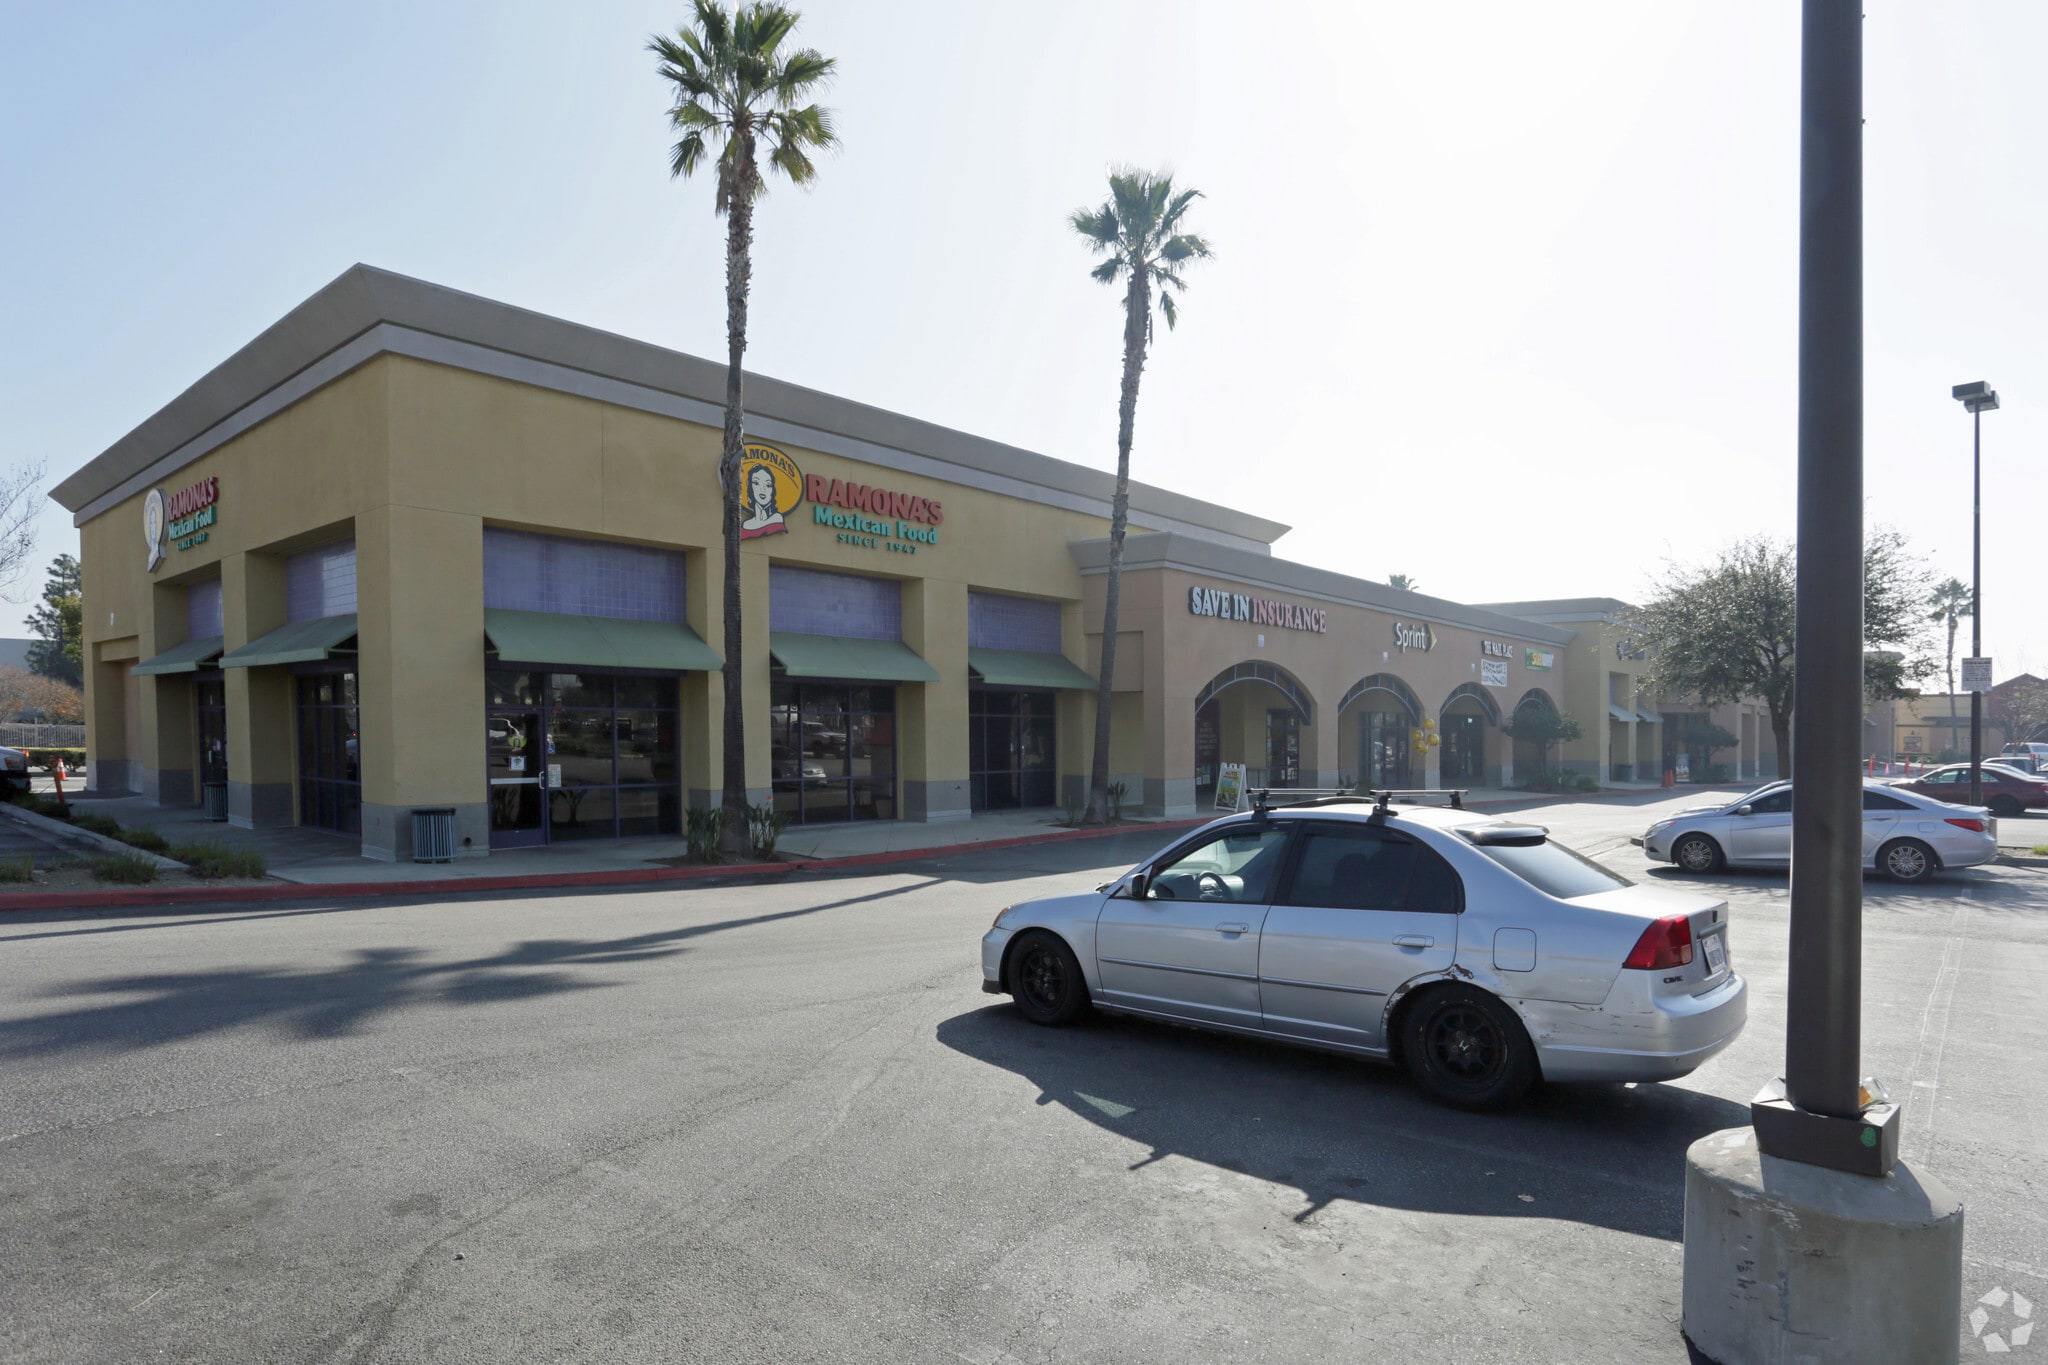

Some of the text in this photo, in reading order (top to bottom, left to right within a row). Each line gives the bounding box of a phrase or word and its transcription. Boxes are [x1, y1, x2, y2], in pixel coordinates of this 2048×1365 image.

[741, 448, 795, 478] AMONA'S
[167, 476, 216, 521] RAMONA'S
[806, 473, 944, 525] RAMONA'S
[168, 505, 213, 541] Mexican Food
[814, 505, 938, 545] Mexican Food
[176, 538, 191, 551] SINCE
[837, 532, 918, 555] SINCE 1947
[1190, 586, 1327, 633] SAVE IN INSURANCE
[1395, 622, 1427, 653] Sprint
